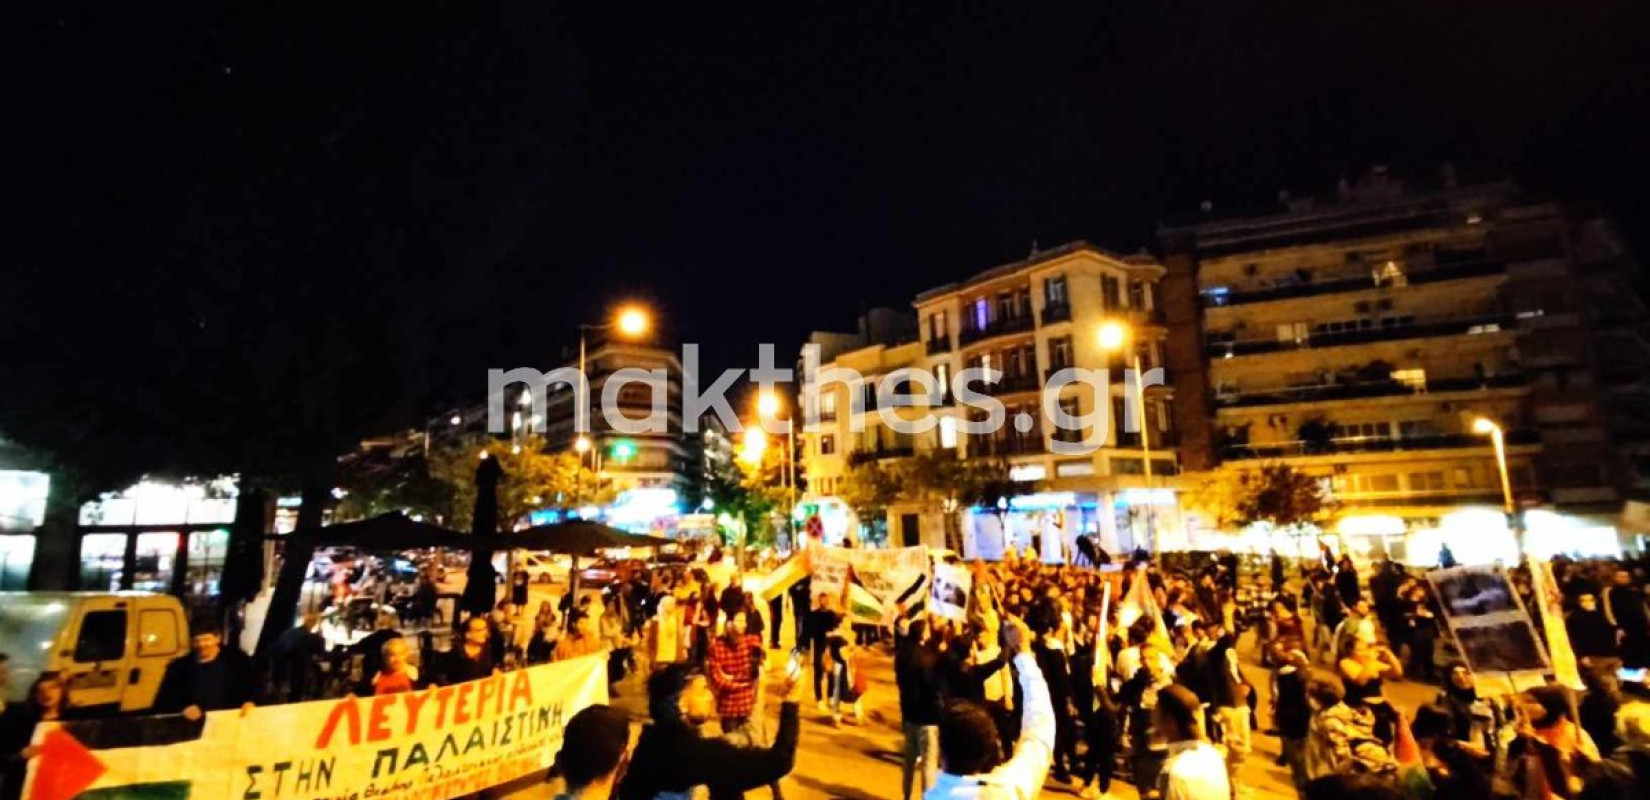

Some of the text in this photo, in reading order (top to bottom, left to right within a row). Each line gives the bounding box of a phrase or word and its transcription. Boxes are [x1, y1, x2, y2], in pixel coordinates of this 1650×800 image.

[243, 755, 336, 800] ΣΤΗΝ
[371, 703, 562, 779] ΠΑΛΑΙΣΤΙΝΗ
[316, 670, 533, 749] ΛΕΥΤΕΡΙΑ
